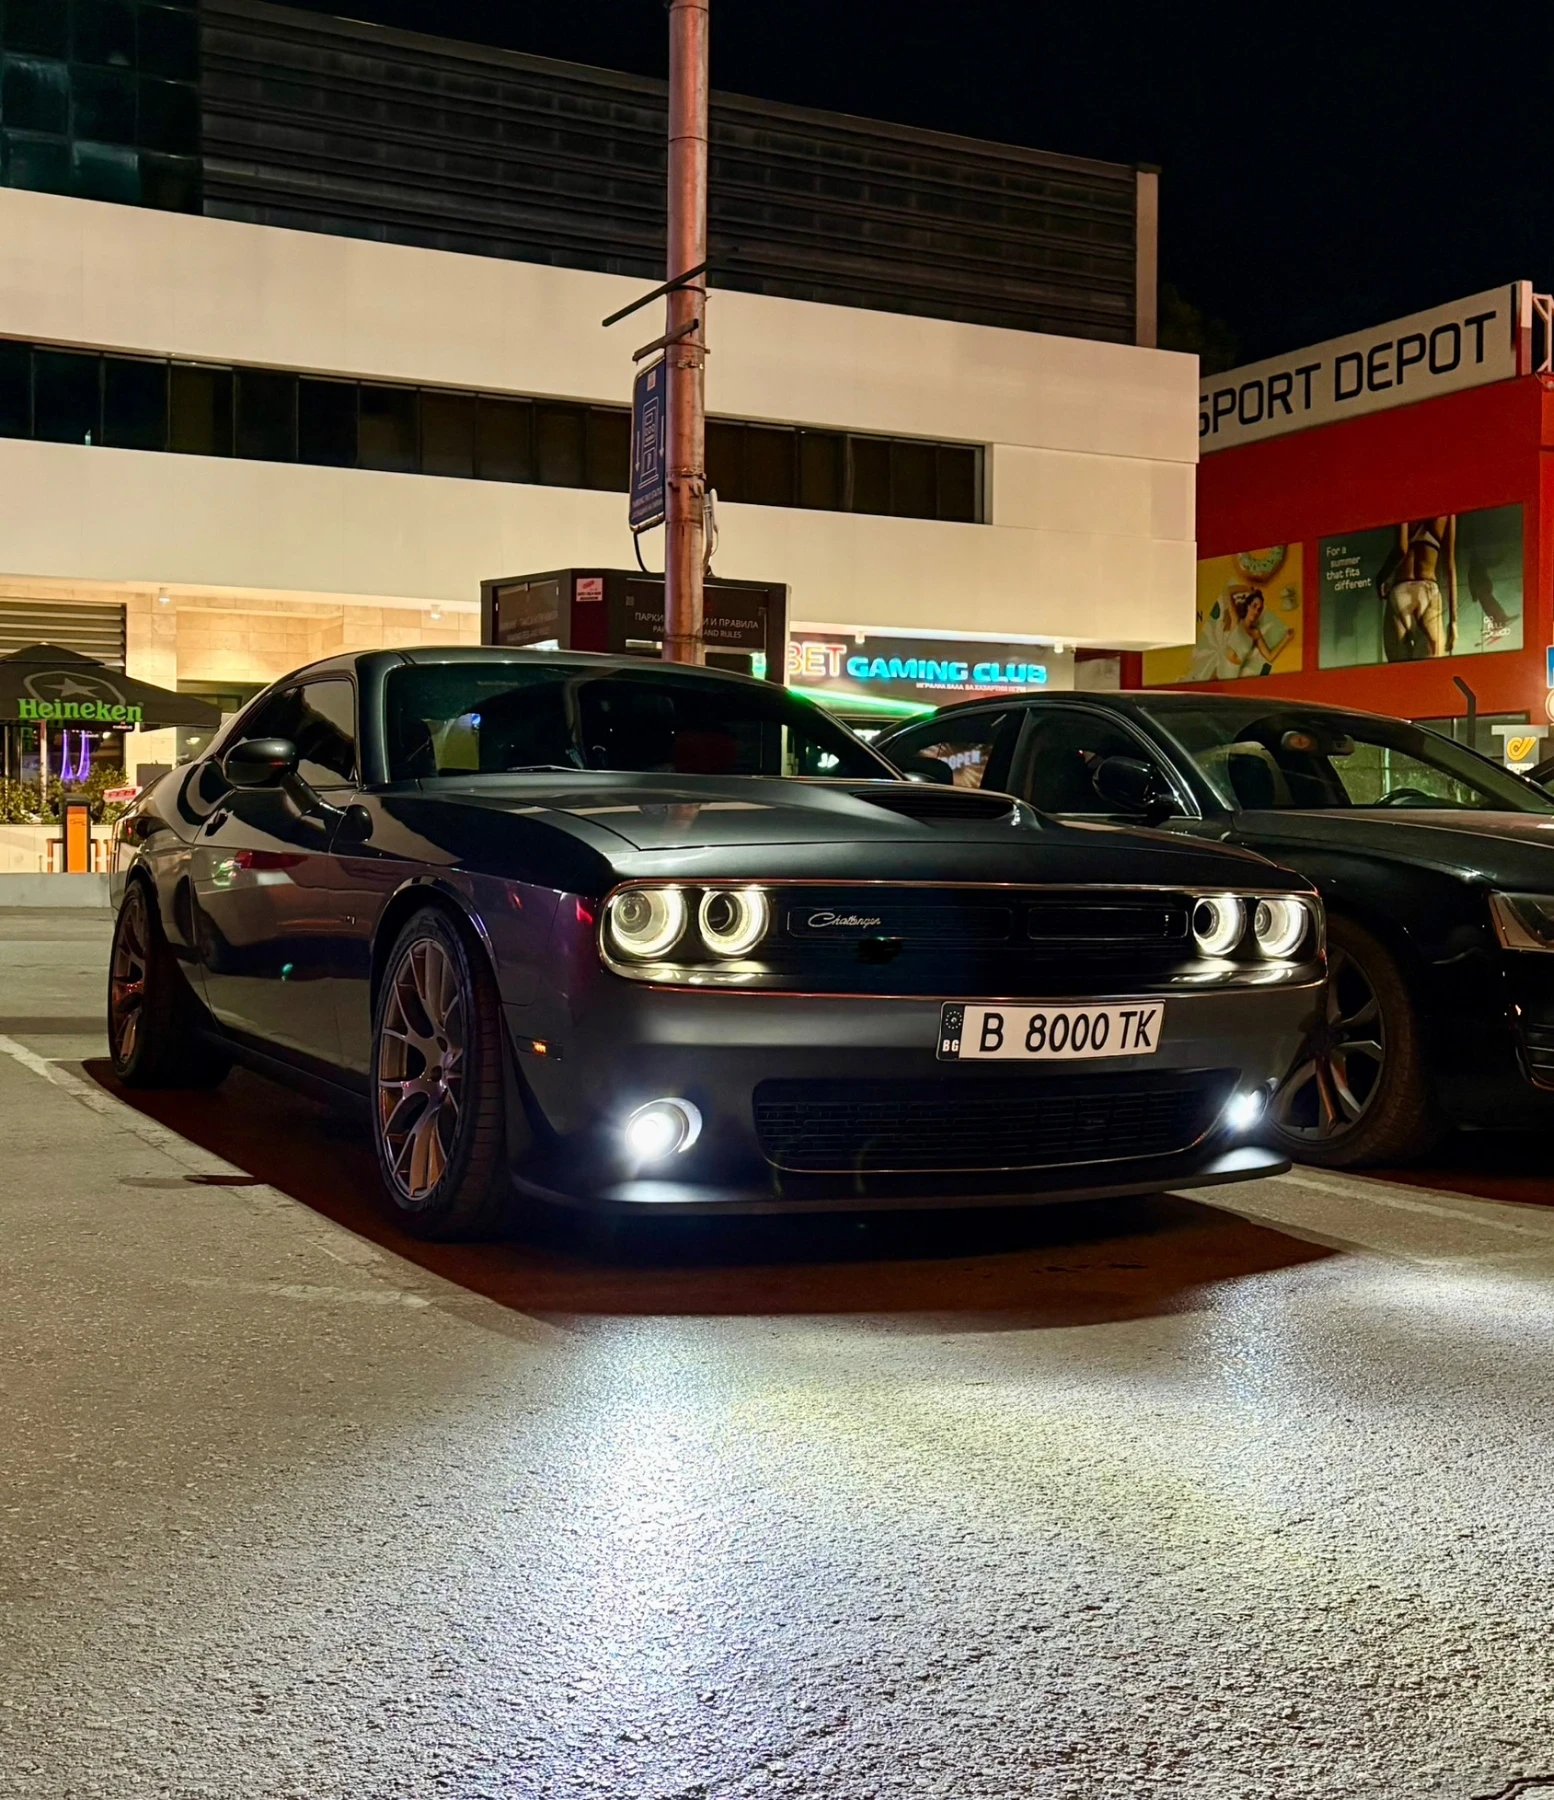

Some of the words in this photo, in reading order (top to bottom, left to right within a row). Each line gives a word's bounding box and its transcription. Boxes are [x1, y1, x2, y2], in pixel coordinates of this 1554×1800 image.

[1335, 311, 1497, 402] DEPOT
[1326, 546, 1340, 557] For
[1341, 546, 1347, 555] a
[1330, 556, 1361, 568] summer
[1326, 570, 1344, 581] that
[1345, 567, 1360, 577] fits
[1334, 577, 1372, 591] different
[718, 618, 759, 629] ПРАВИЛА
[703, 629, 719, 637] AND
[720, 630, 742, 639] RULES
[788, 641, 847, 677] BET
[847, 656, 969, 681] GAMING
[973, 662, 1047, 684] CLUB
[18, 699, 143, 722] Heineken
[808, 912, 881, 929] Challenger
[979, 1012, 1004, 1052] B
[1025, 1012, 1110, 1052] 8000
[1119, 1009, 1157, 1049] TK
[942, 1039, 959, 1052] BG
